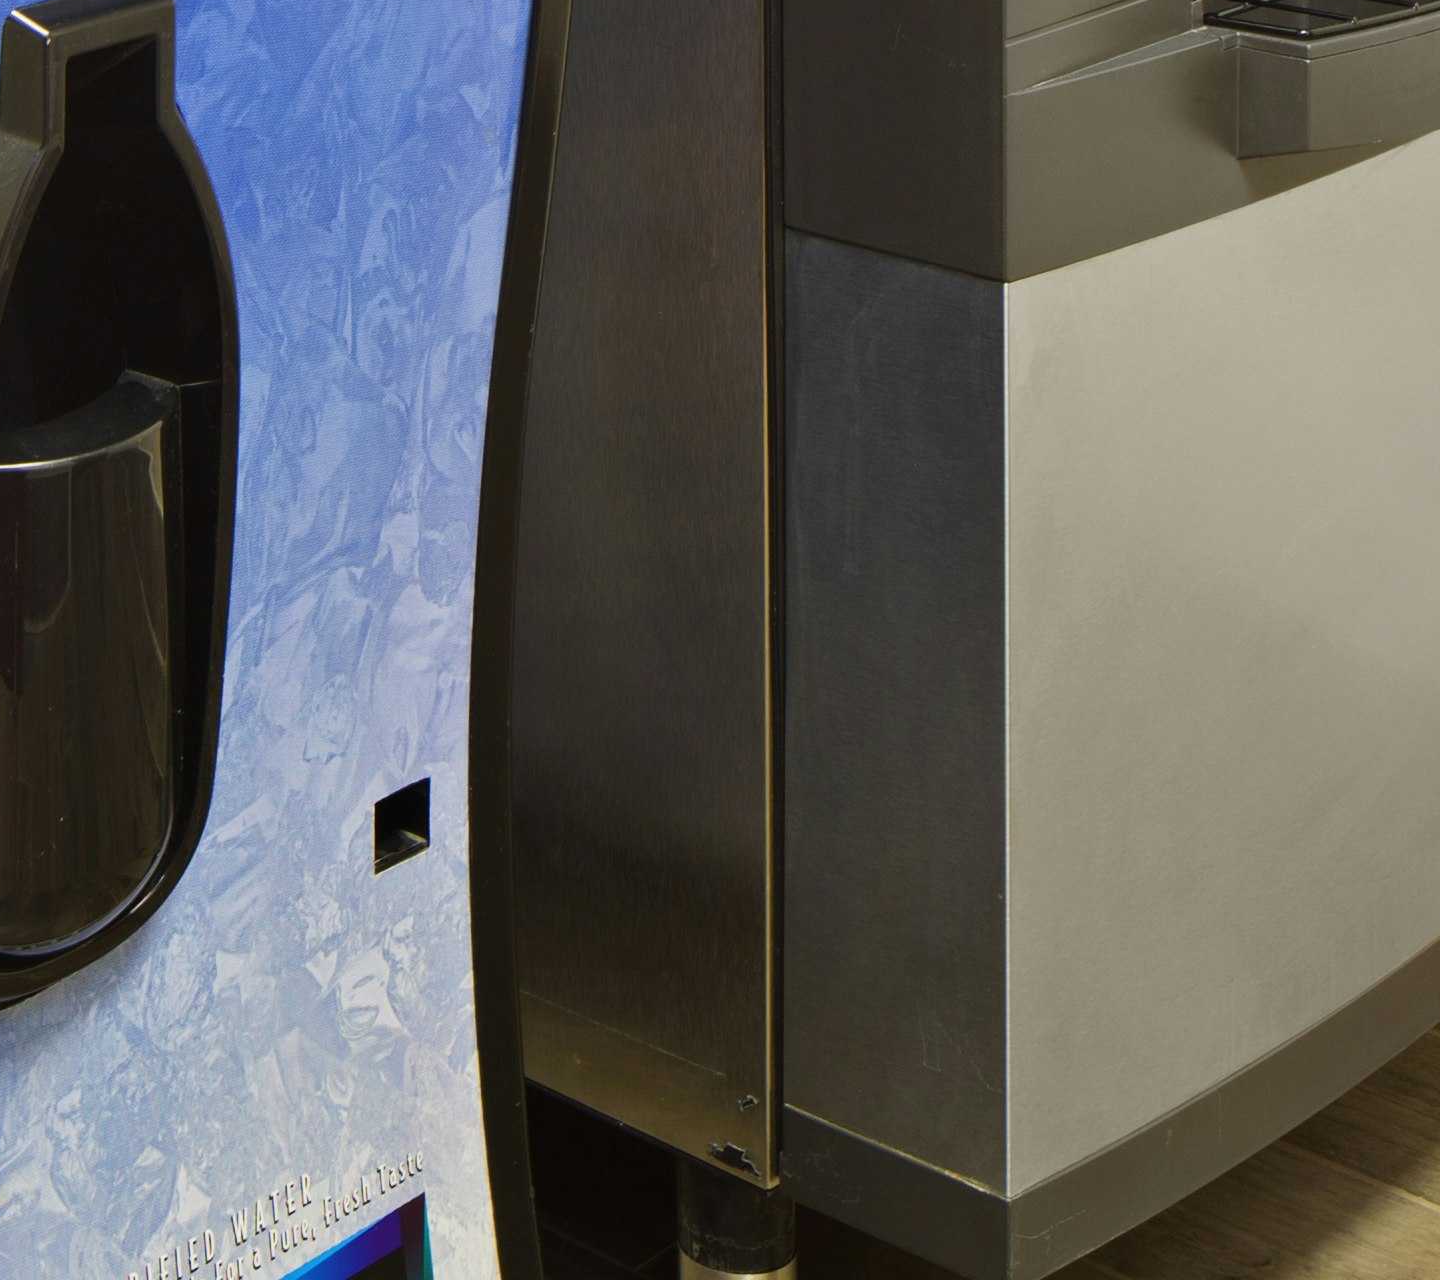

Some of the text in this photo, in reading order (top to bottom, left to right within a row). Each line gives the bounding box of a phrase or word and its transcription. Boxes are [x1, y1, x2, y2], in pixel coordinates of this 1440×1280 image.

[230, 1172, 312, 1247] WATER
[252, 1150, 424, 1270] a Pure, Fresh Taste
